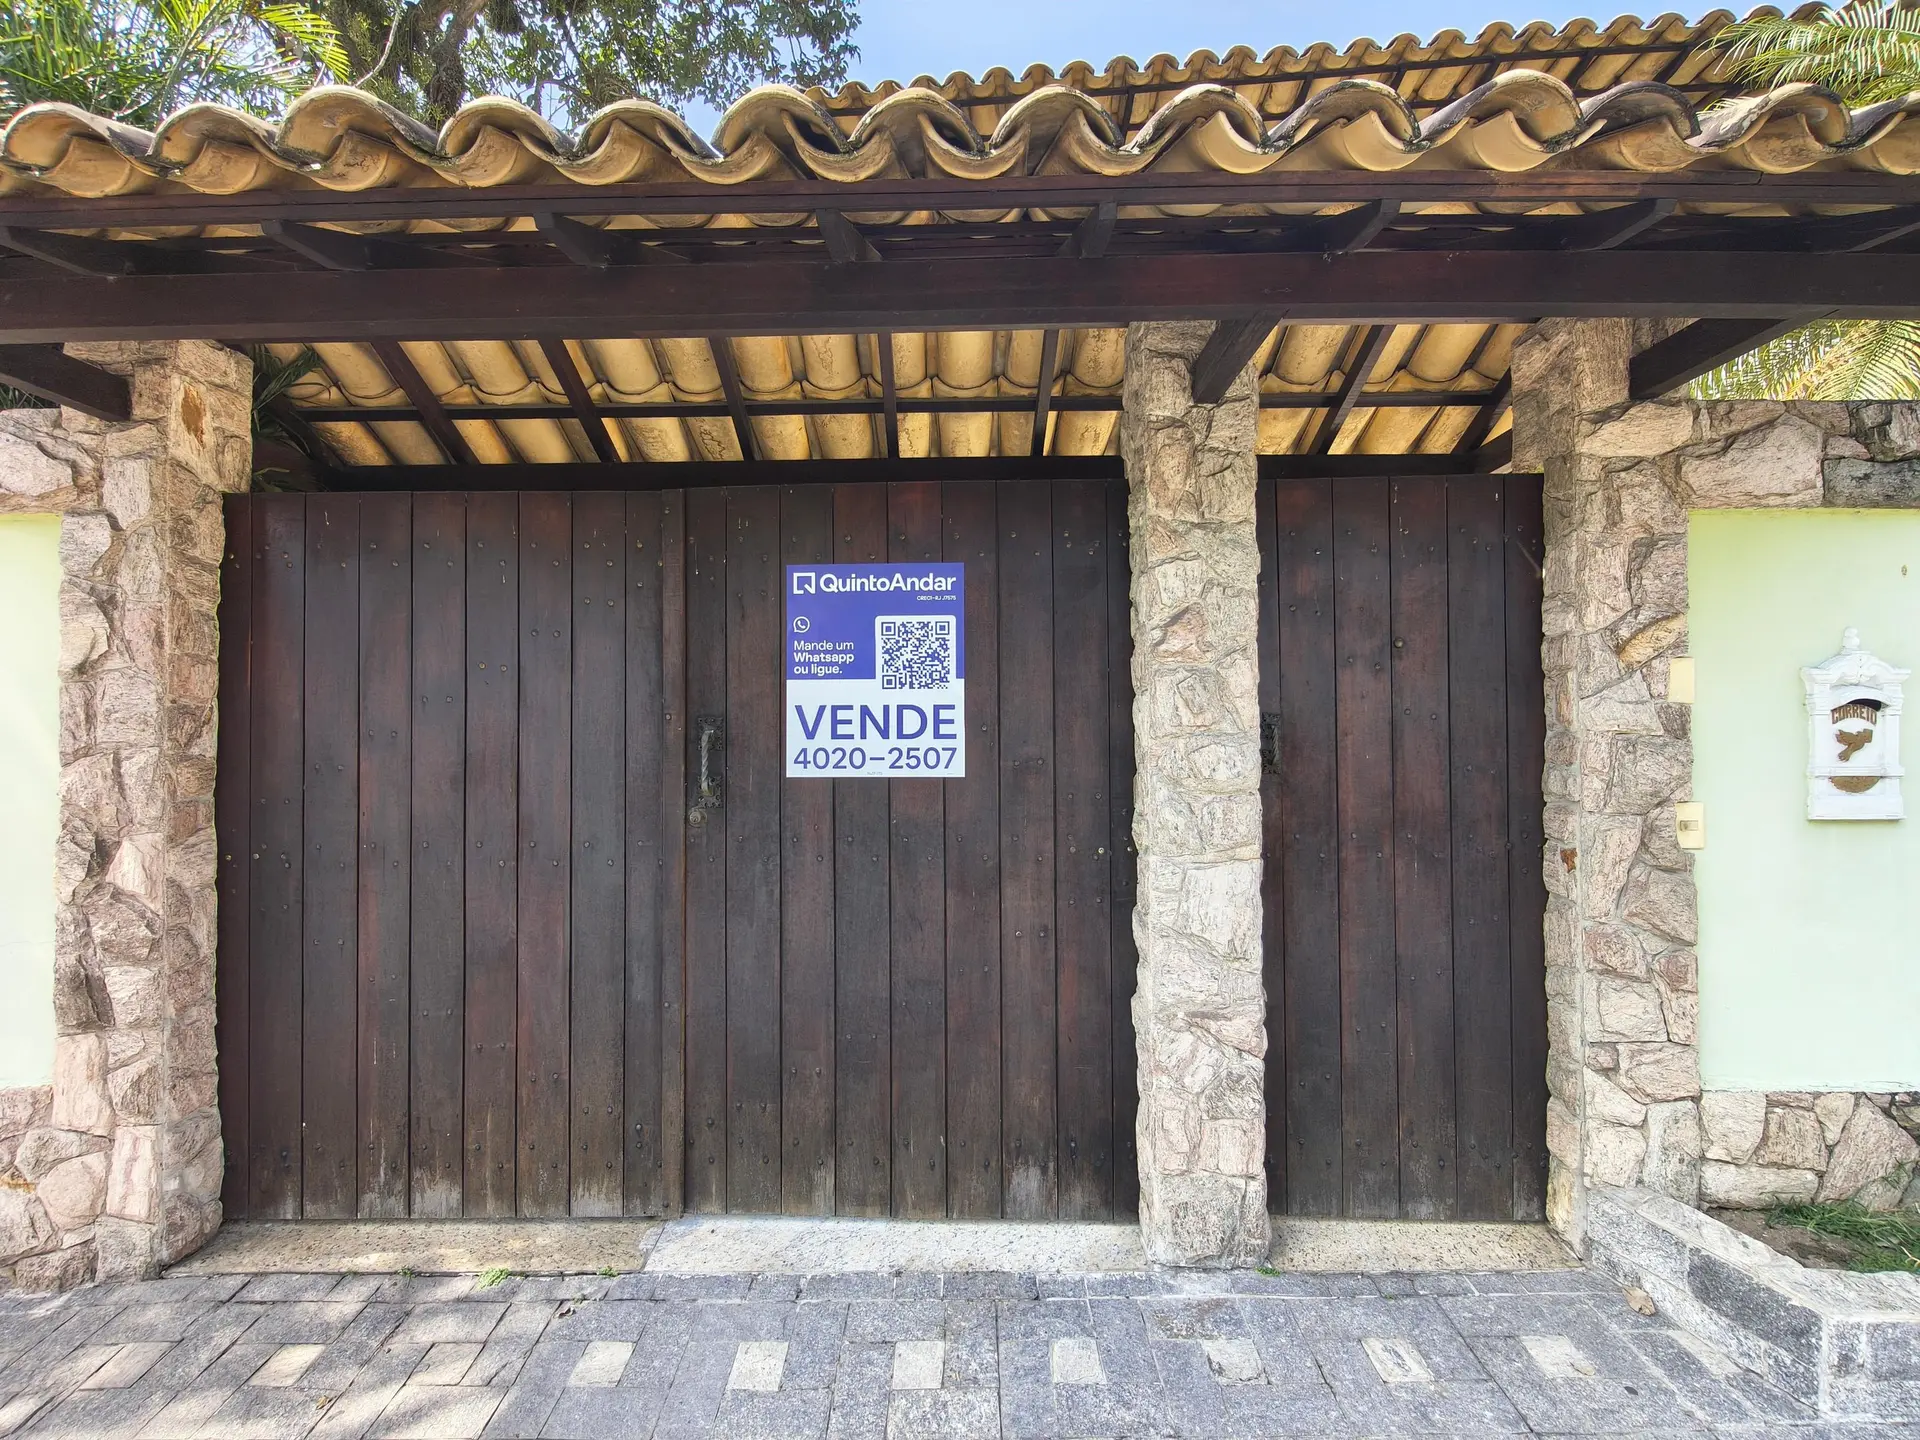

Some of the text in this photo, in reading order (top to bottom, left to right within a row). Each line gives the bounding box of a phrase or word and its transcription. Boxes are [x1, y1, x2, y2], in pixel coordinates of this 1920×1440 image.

[820, 573, 956, 593] QuintoAndar
[794, 641, 854, 651] Mande um
[794, 652, 854, 664] Whatsapp
[794, 664, 843, 677] ou ligue.
[795, 704, 957, 740] VENDE
[1831, 703, 1877, 726] CORREIO
[793, 747, 957, 770] 4020-2507
